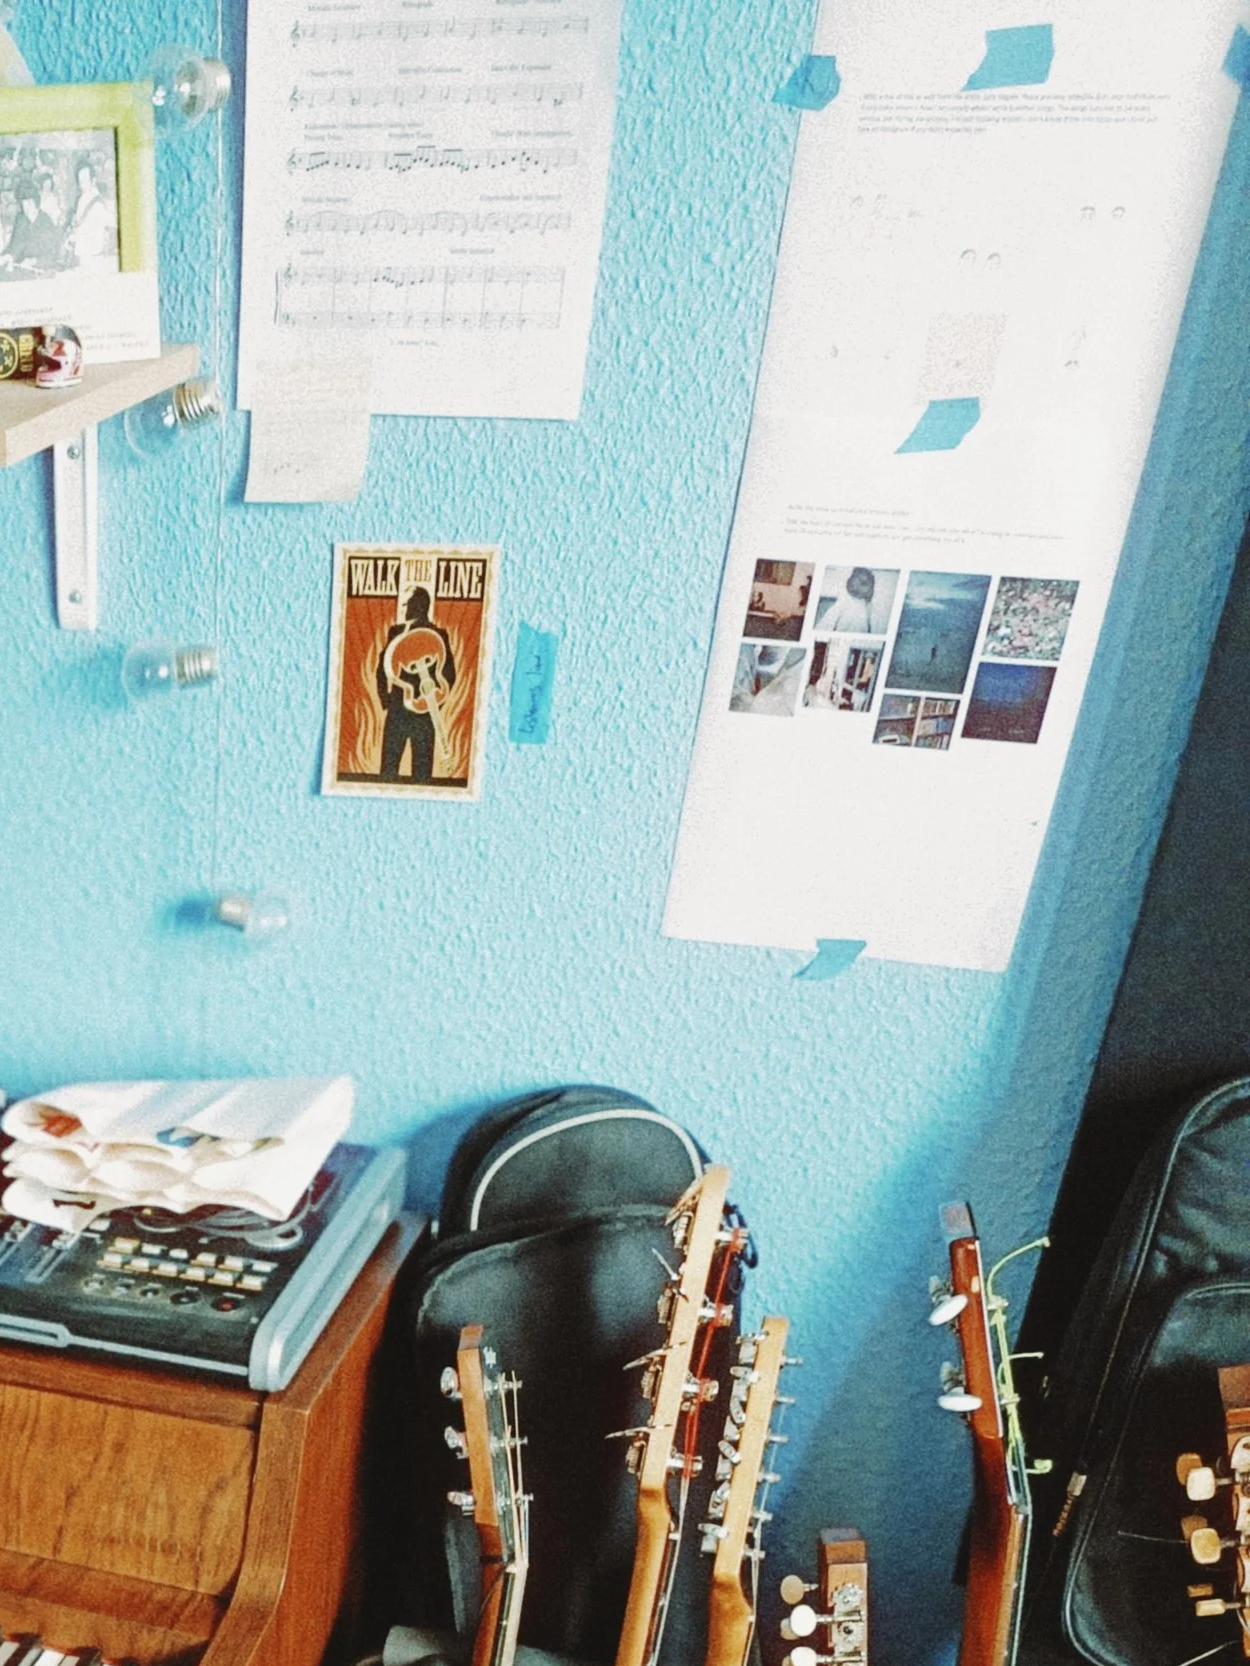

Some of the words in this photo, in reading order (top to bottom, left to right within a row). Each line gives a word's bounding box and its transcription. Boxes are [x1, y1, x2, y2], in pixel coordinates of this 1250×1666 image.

[350, 559, 400, 597] WALK
[405, 559, 432, 582] THE
[436, 560, 484, 599] LINE
